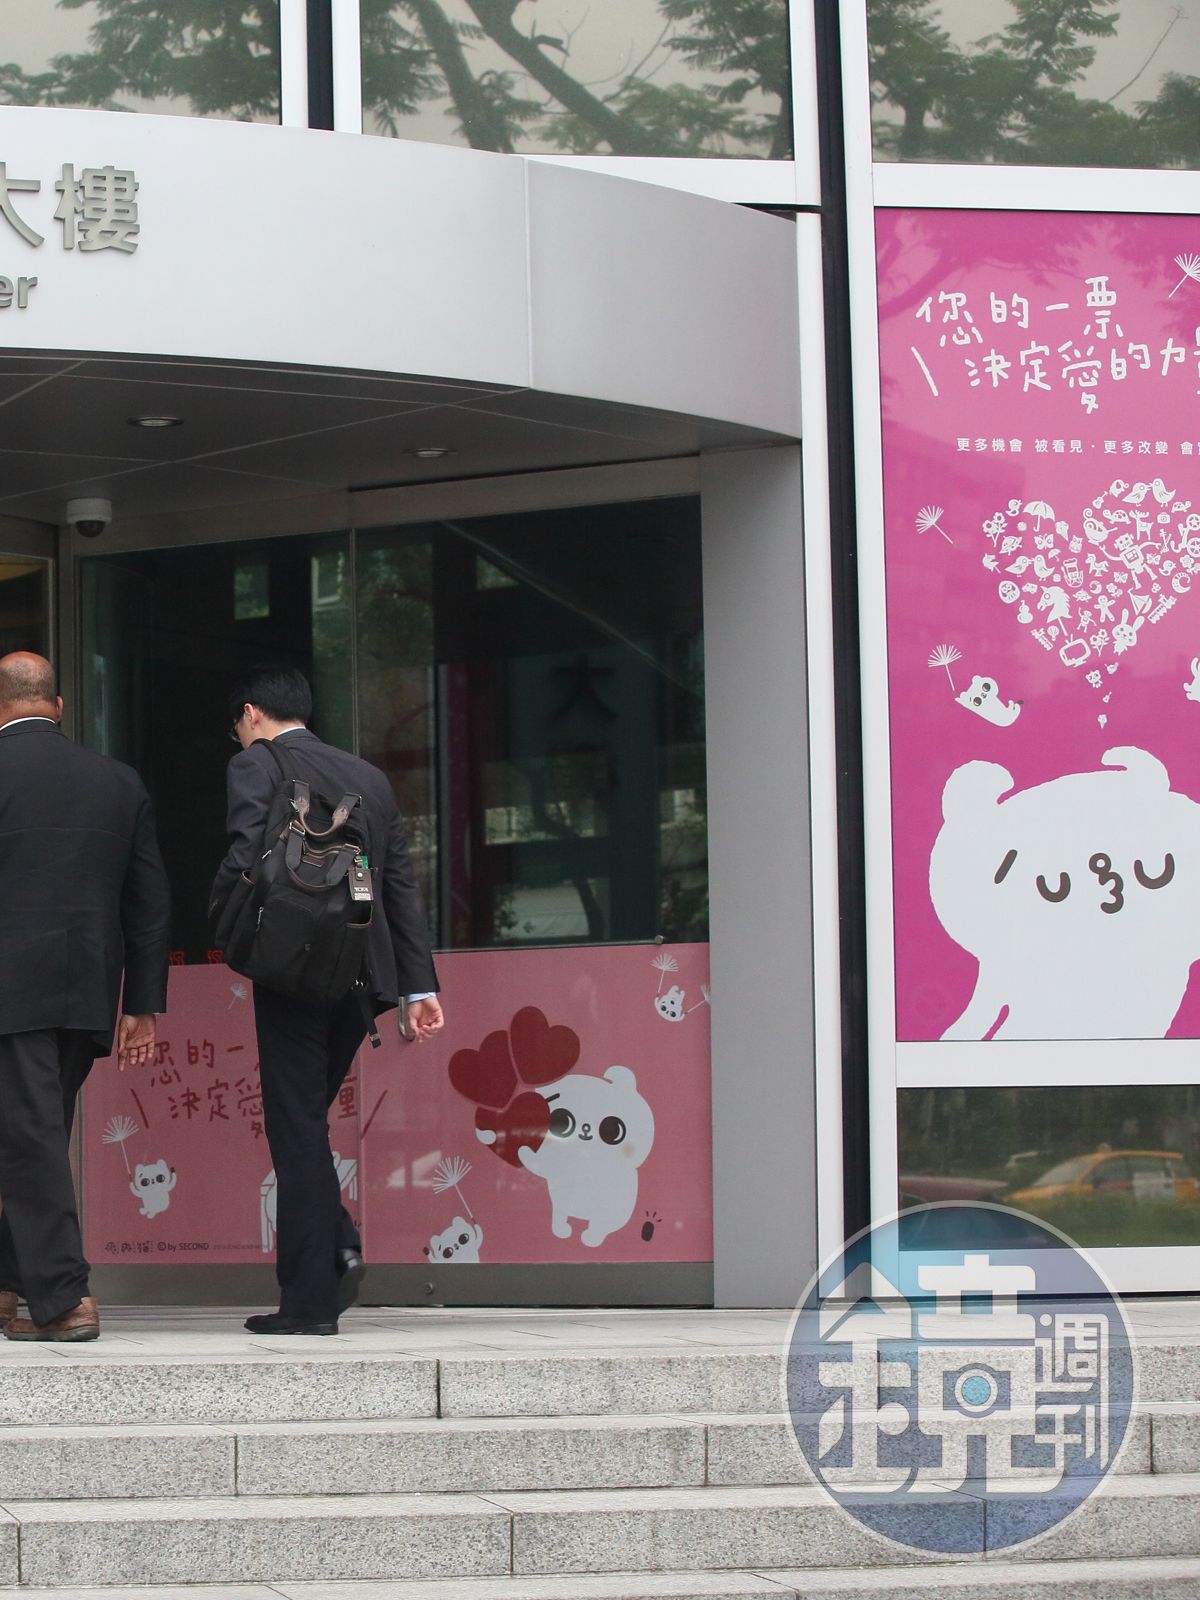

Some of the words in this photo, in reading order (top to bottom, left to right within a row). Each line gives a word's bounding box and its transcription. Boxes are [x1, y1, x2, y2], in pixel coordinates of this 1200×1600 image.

[915, 275, 1124, 347] 您的一票
[964, 326, 1200, 414] 決定愛的力
[957, 438, 1023, 453] 更多機會
[179, 1242, 209, 1251] SECOND
